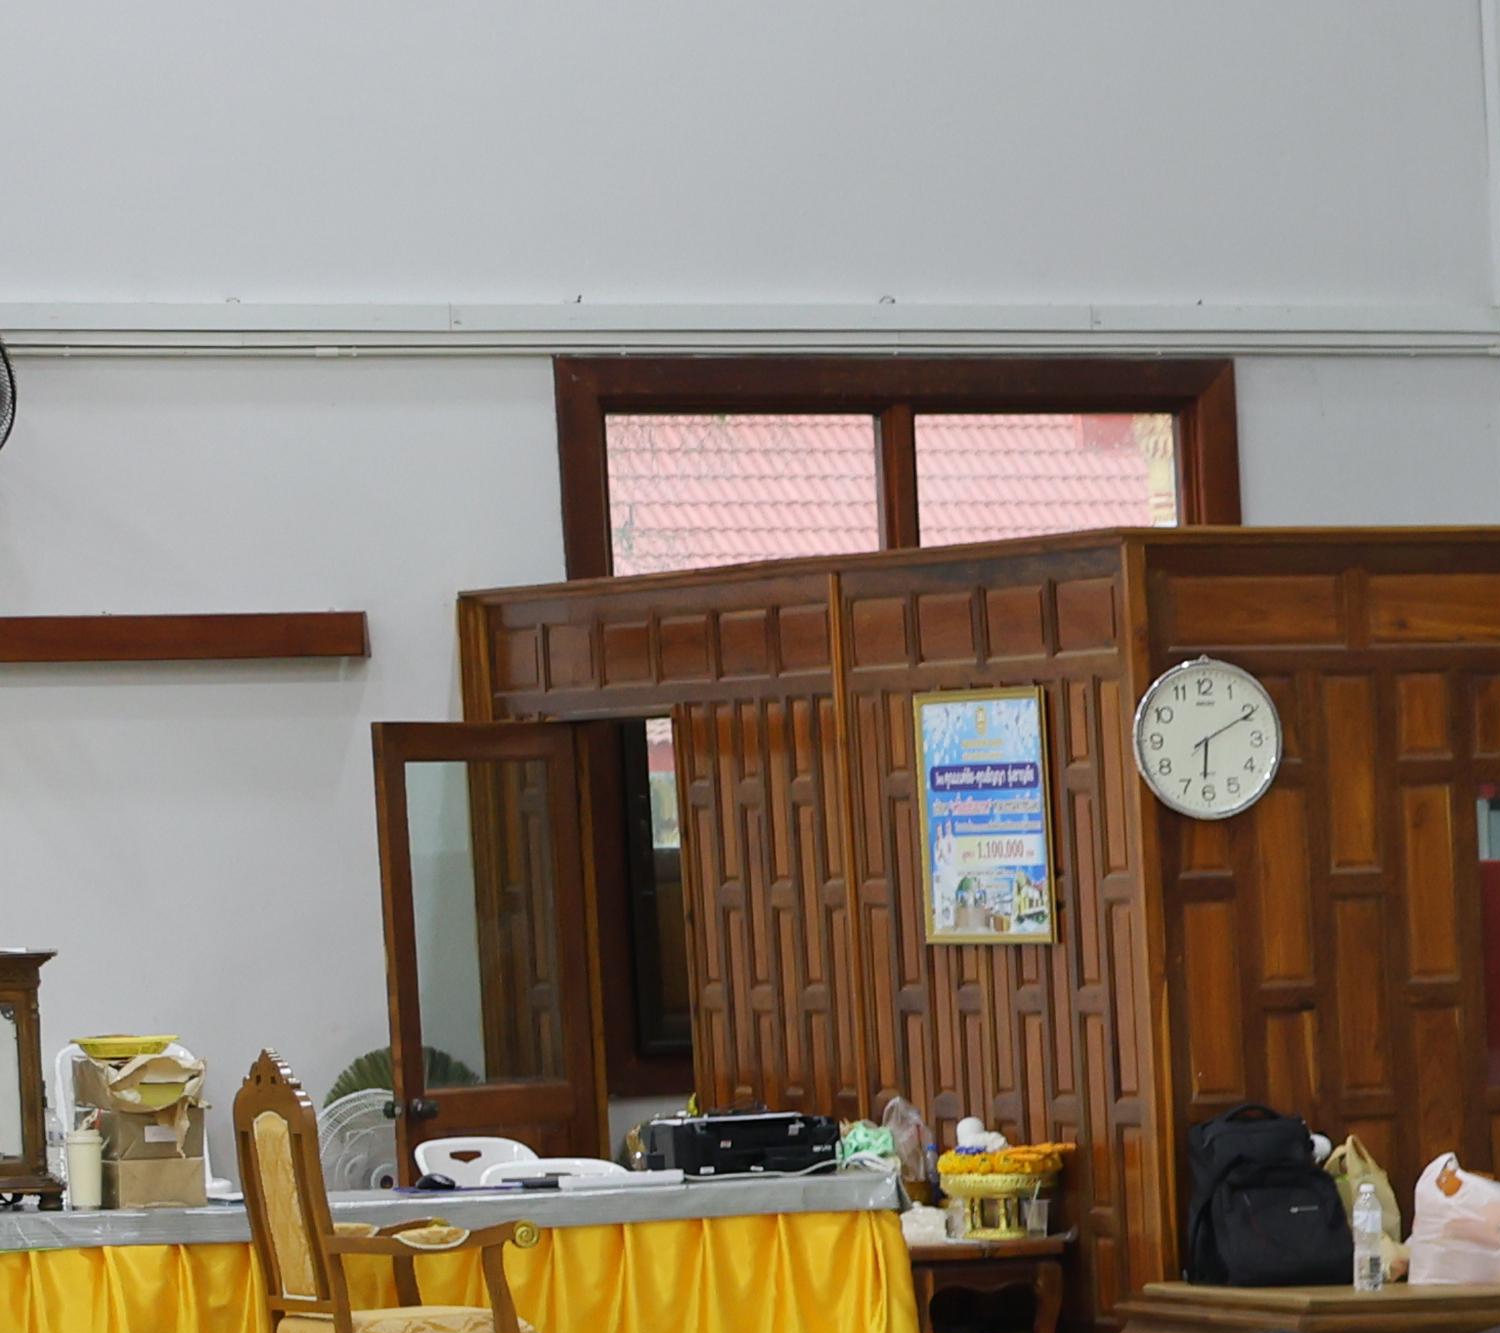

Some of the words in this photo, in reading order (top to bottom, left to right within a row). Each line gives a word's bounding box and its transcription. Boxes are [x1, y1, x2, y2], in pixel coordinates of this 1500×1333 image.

[1174, 685, 1186, 700] 11
[1197, 678, 1213, 696] 12
[1227, 685, 1233, 699] 1
[1155, 707, 1174, 724] 10
[1242, 704, 1254, 721] 2
[1150, 733, 1164, 750] 9
[1250, 731, 1263, 747] 3
[1159, 758, 1172, 775] 8
[1244, 757, 1255, 773] 4
[1180, 778, 1192, 794] 7
[1202, 785, 1215, 801] 6
[1227, 777, 1240, 793] 5
